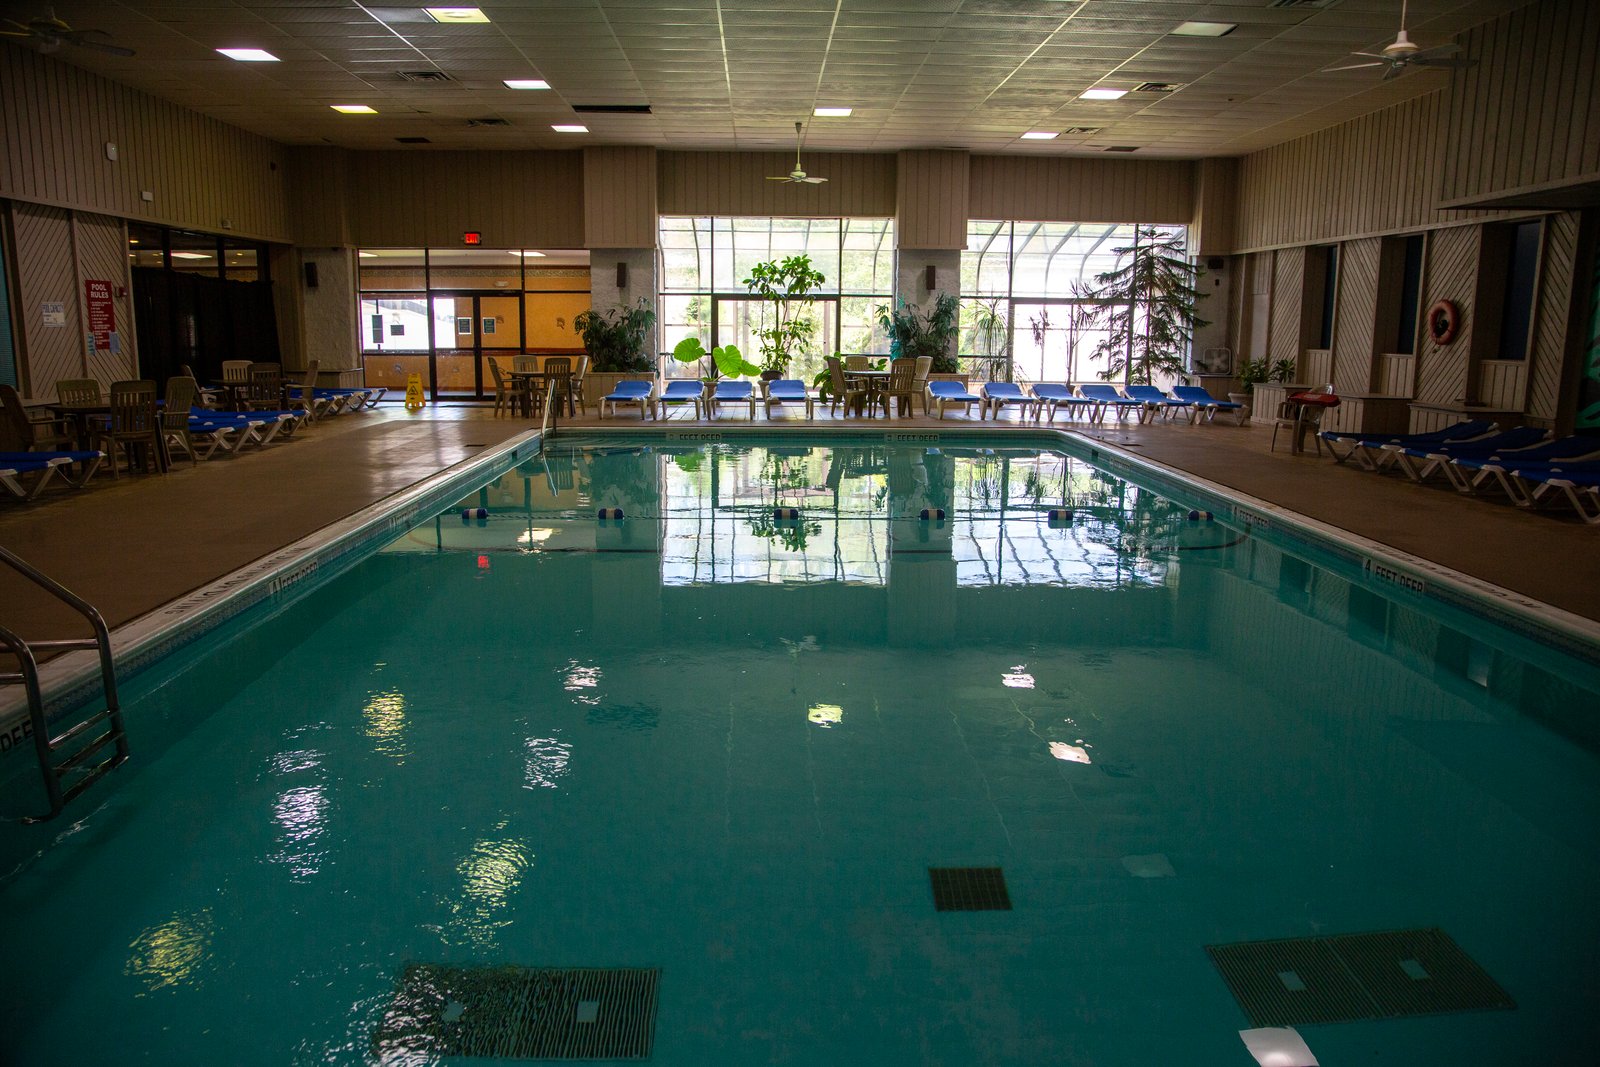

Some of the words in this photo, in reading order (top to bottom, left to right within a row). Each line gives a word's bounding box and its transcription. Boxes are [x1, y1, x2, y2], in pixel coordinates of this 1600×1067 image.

[90, 291, 109, 299] RULES
[91, 283, 106, 291] POOL
[1375, 566, 1397, 582] FEET
[1400, 575, 1423, 593] DEEP
[0, 720, 33, 752] DEE
